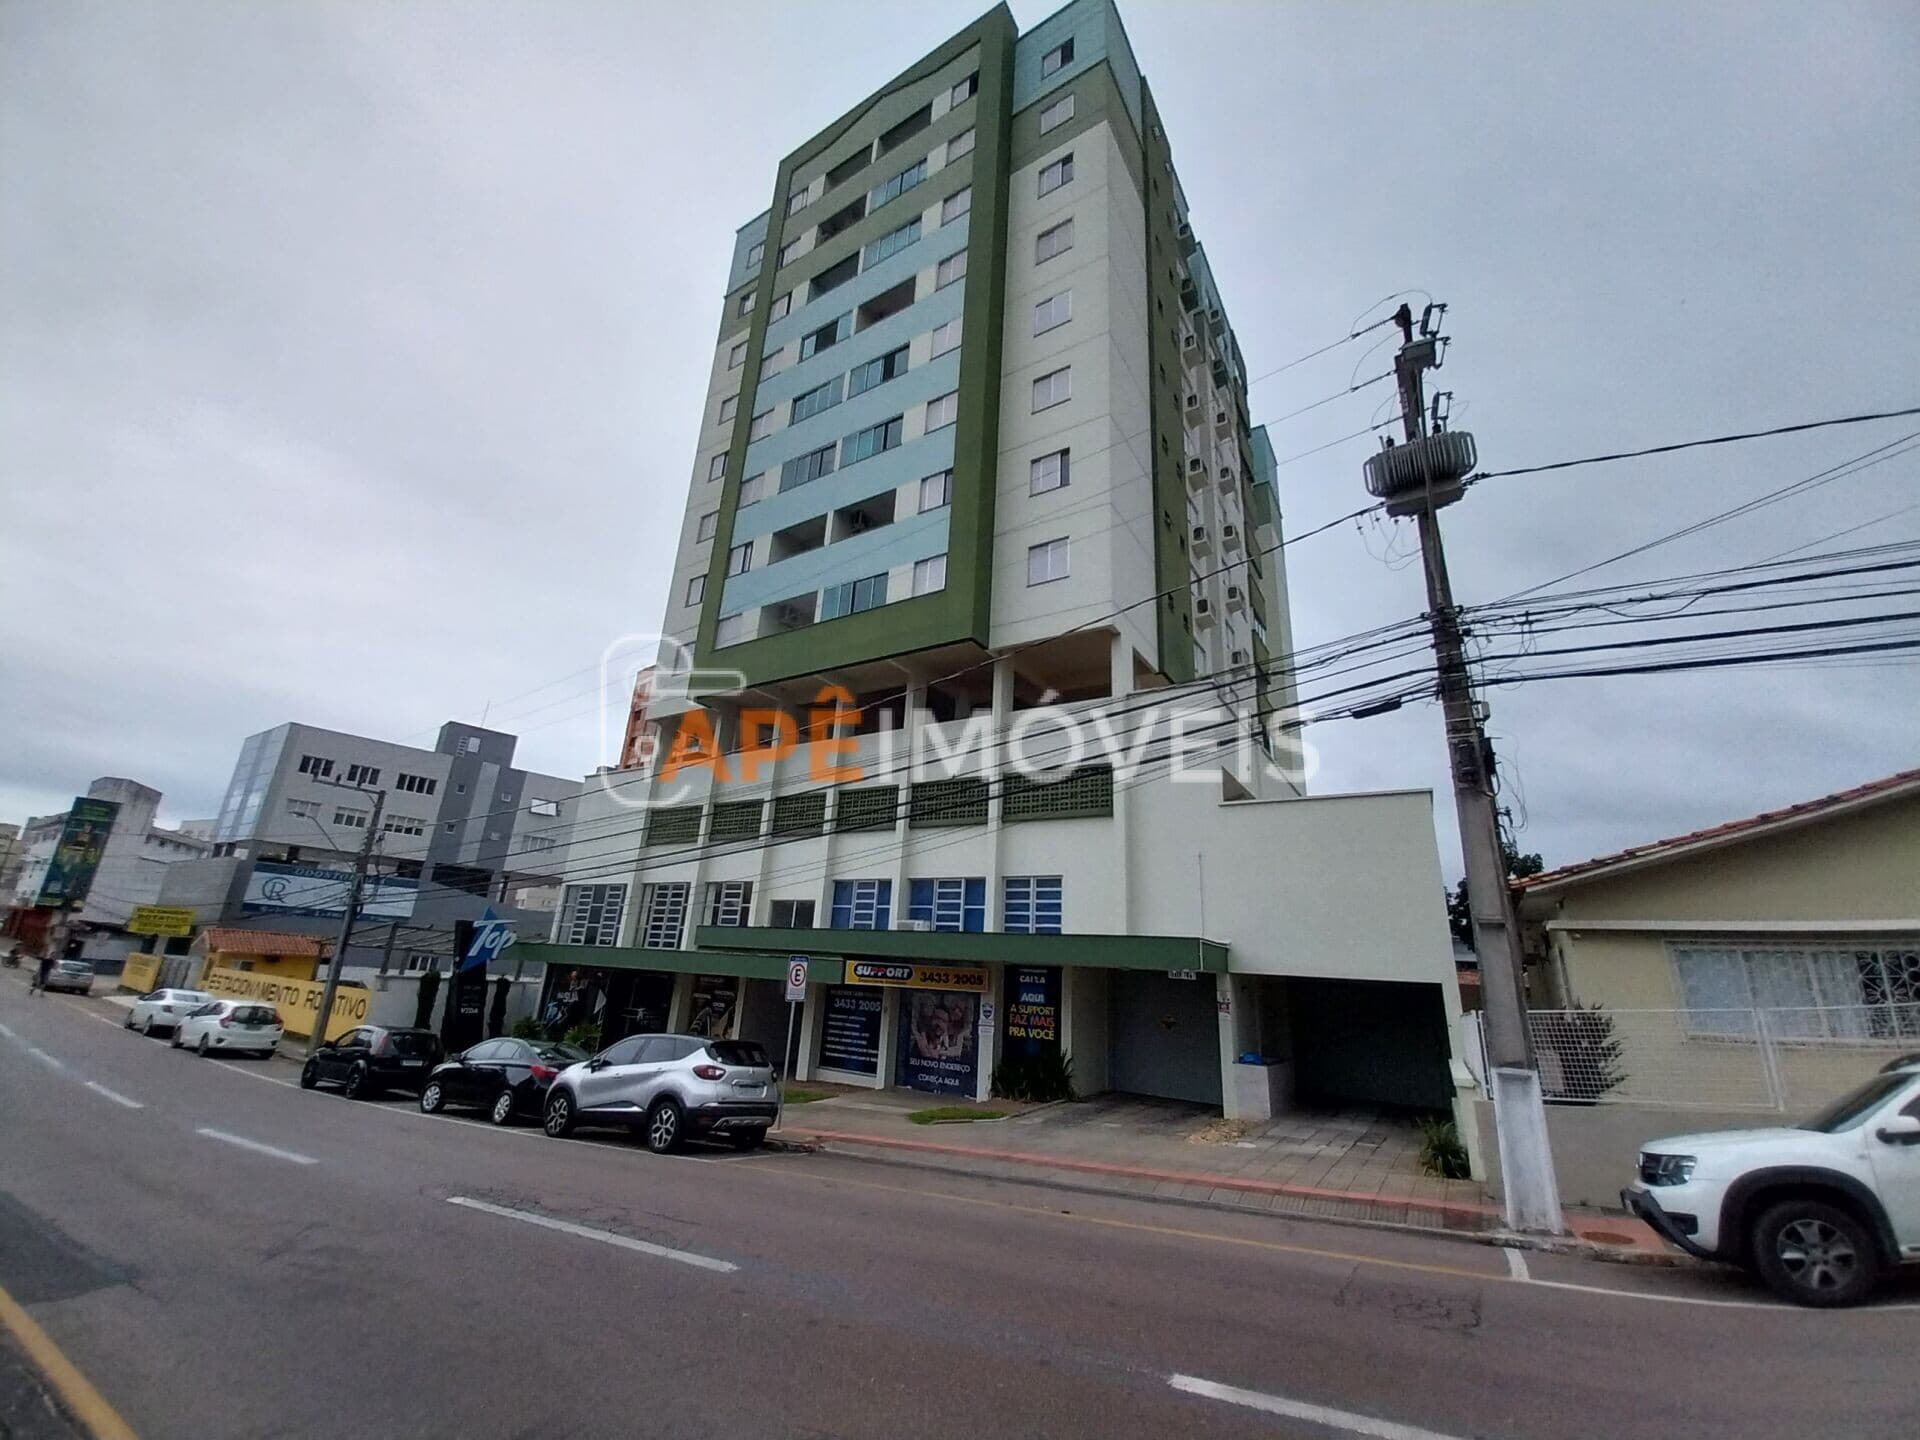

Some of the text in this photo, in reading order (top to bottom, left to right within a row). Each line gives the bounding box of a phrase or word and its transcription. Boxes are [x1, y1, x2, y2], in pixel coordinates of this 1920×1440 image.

[467, 920, 518, 960] Top
[794, 968, 802, 983] E
[855, 964, 910, 979] SUPPORT
[919, 971, 950, 984] 3433
[953, 973, 984, 986] 2005
[208, 973, 299, 1006] ESTACIONAMENTO
[834, 998, 881, 1012] 3433 2005
[1018, 1004, 1056, 1016] SUPPORT
[1008, 1026, 1026, 1037] PRA
